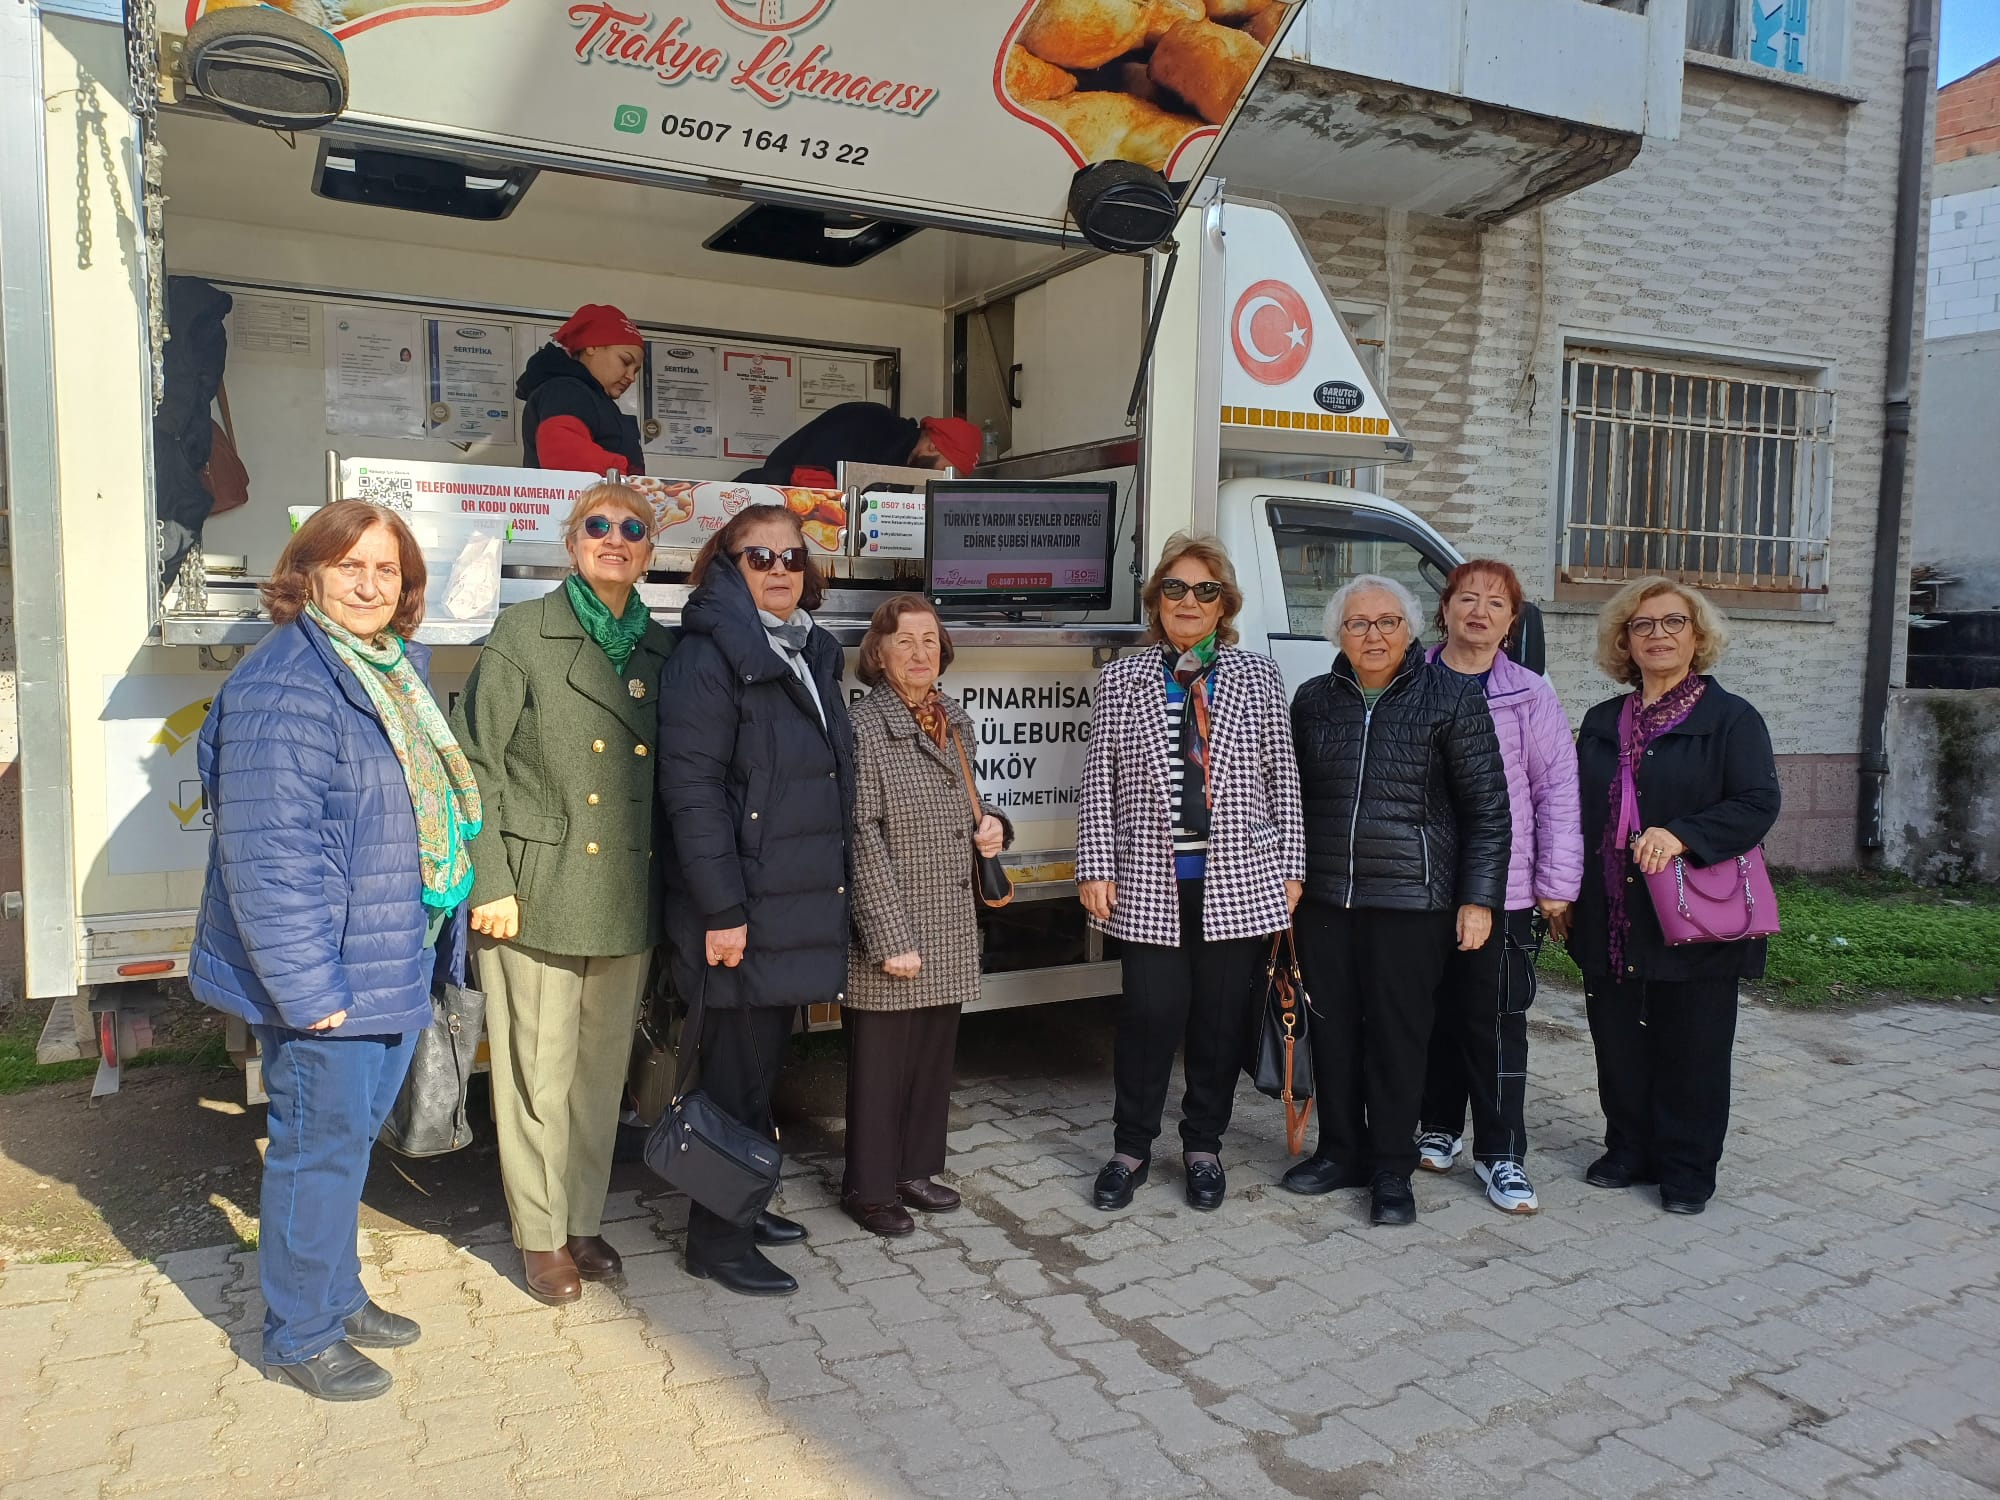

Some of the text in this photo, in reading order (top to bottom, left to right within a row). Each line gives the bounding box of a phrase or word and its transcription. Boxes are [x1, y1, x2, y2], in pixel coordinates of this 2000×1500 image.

[568, 4, 934, 112] Trakya Lokmacısı
[661, 114, 869, 166] 0507 164 13 22
[416, 480, 511, 497] TELEFONUNUZDAN
[514, 486, 565, 500] KAMERAYI
[461, 500, 550, 515] QR KODU OKUTUN
[944, 510, 1102, 527] TÜRKİYE YARDIM SEVENLER DERNEĞİ
[964, 531, 1081, 551] EDİRNE ŞUBESİ HAYRATIDIR
[976, 717, 1091, 745] ÜLEBURG
[973, 752, 1037, 780] NKÖY
[997, 785, 1080, 806] HİZMETİNİZ
